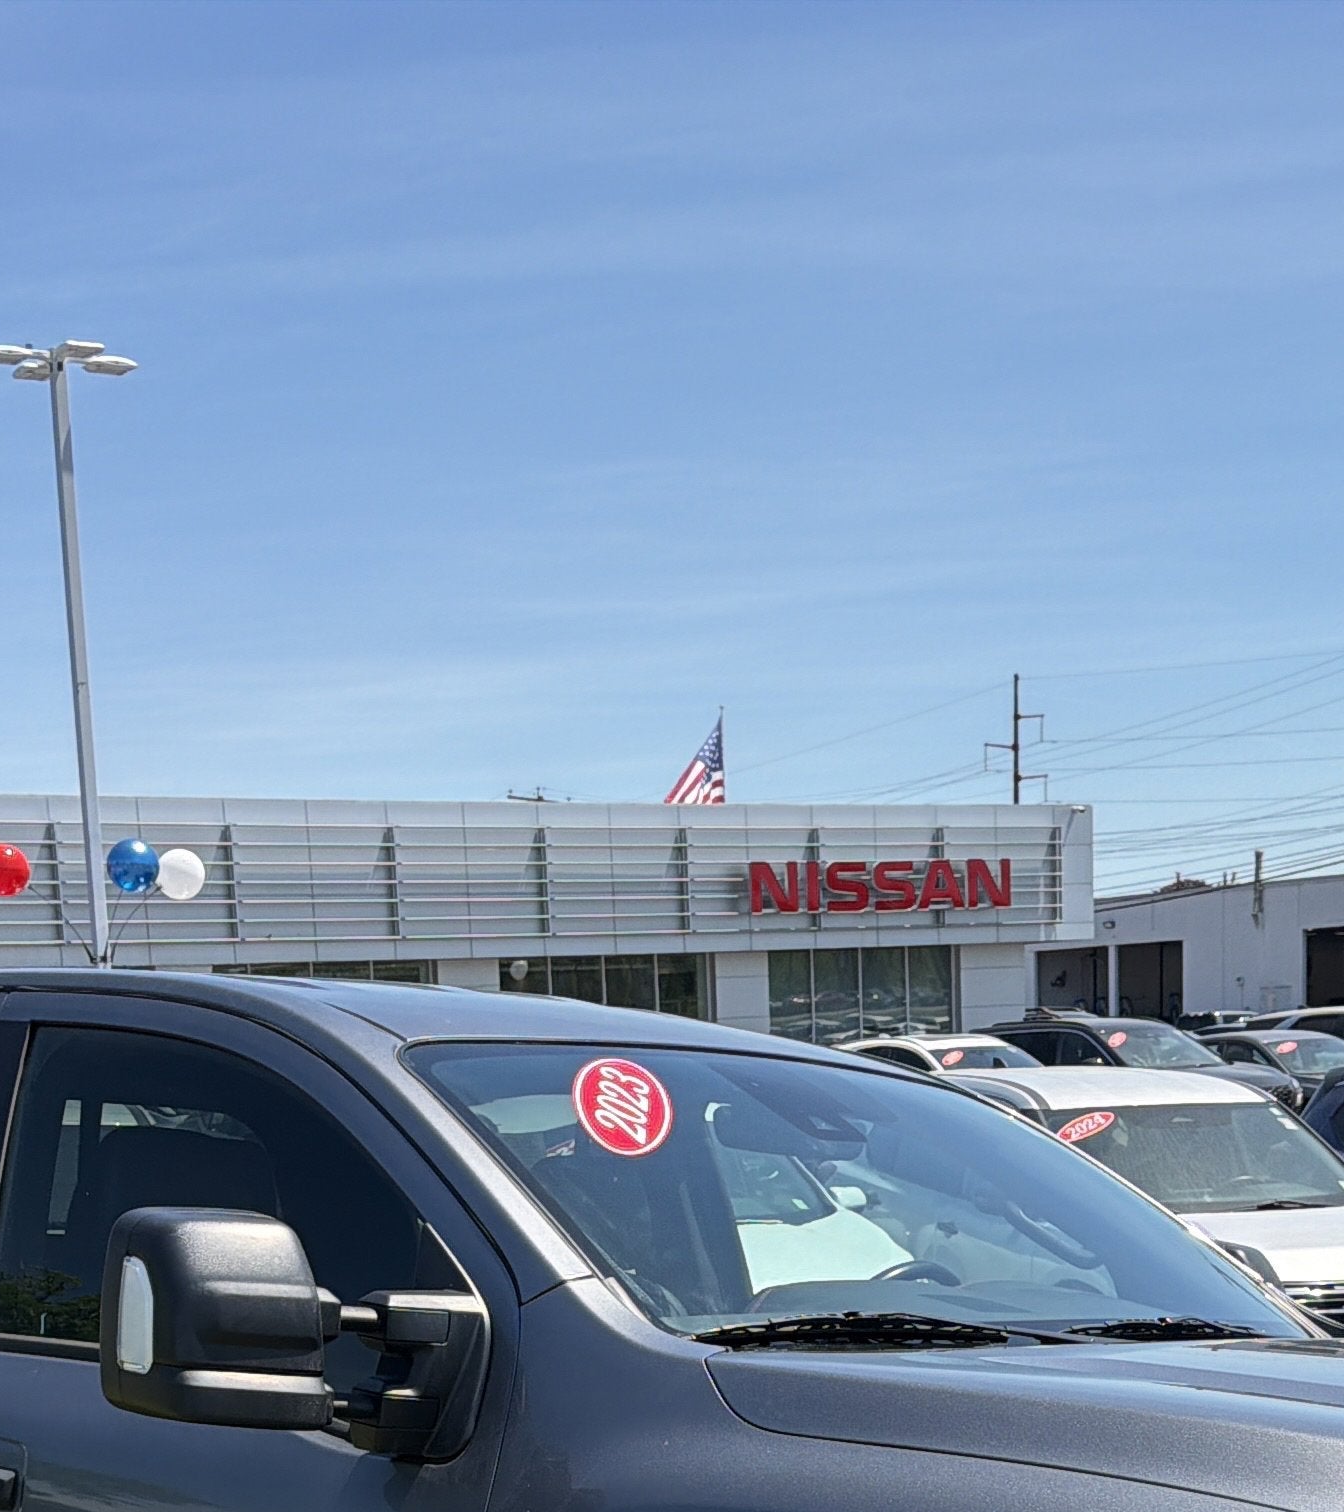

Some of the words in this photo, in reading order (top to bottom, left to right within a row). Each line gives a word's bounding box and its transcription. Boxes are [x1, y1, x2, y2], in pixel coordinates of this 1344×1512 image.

[749, 858, 1012, 915] NISSAN
[594, 1065, 650, 1146] 2023
[1068, 1113, 1107, 1140] 2024
